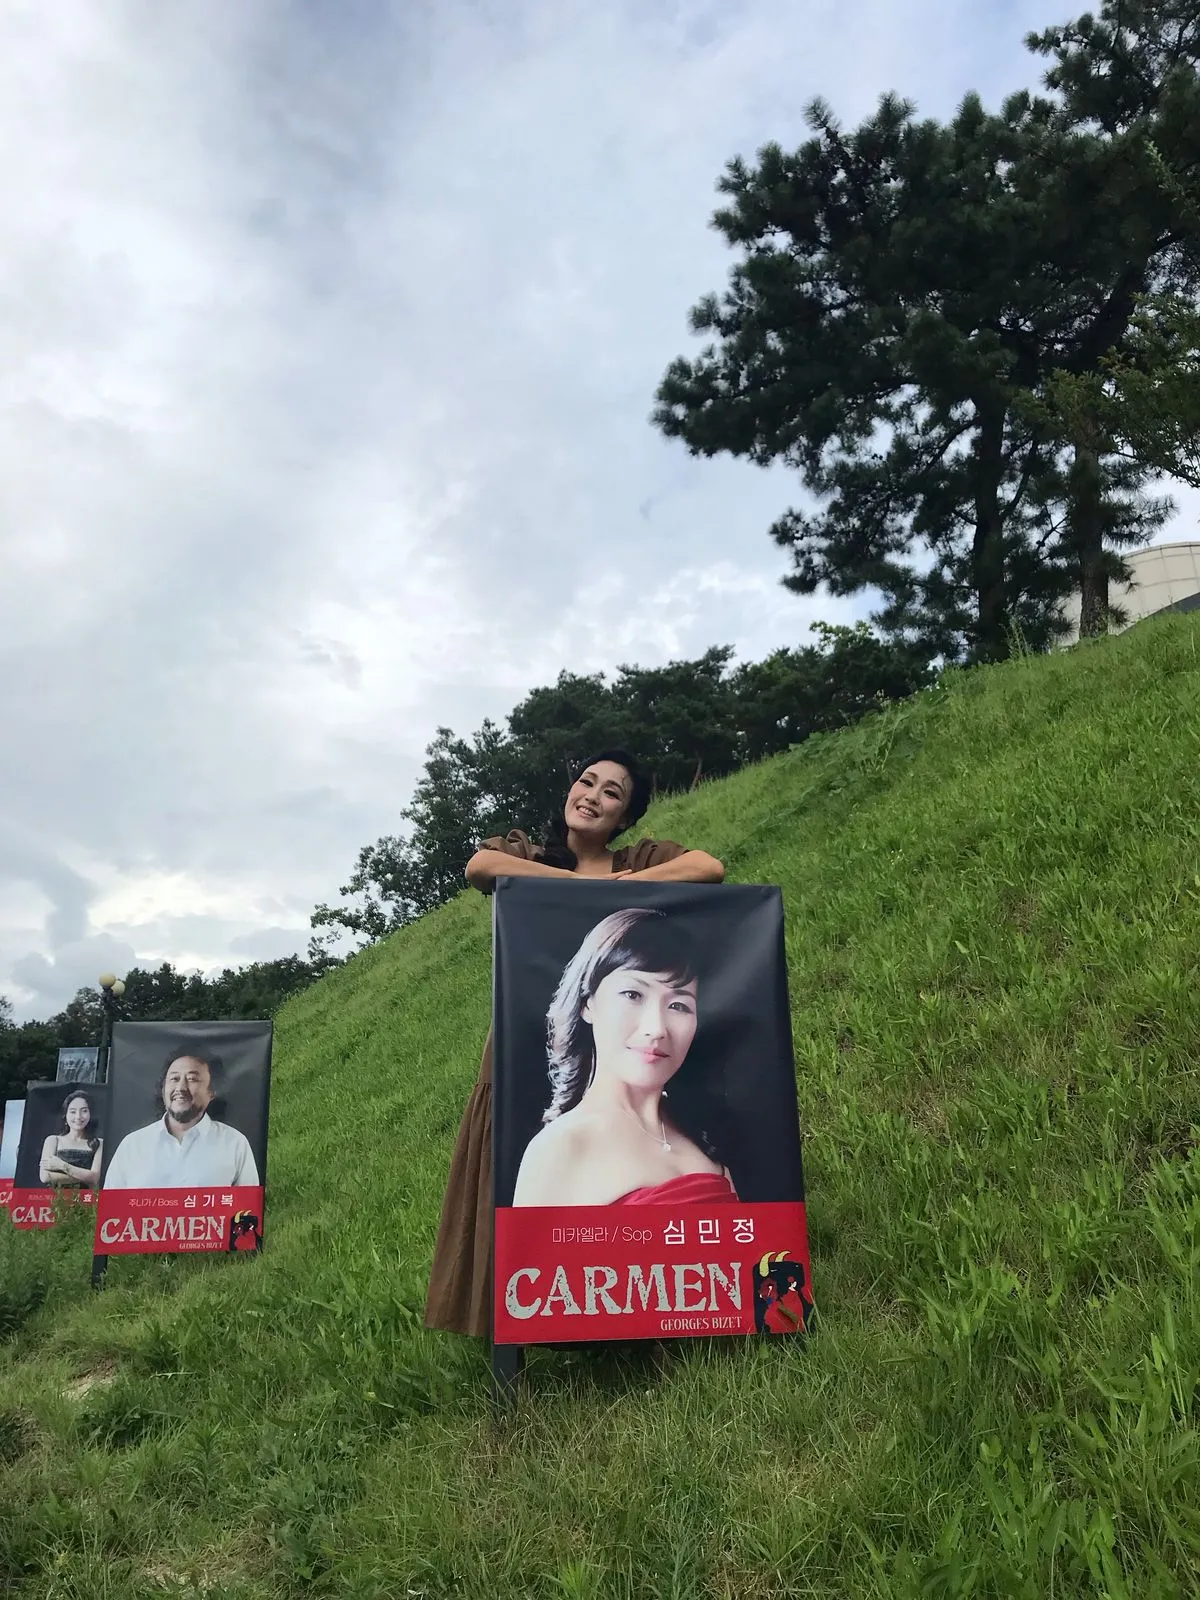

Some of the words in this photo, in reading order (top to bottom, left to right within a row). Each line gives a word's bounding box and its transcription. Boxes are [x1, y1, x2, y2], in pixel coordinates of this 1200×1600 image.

[100, 1215, 226, 1244] CARMEN
[505, 1262, 742, 1319] CARMEN
[660, 1317, 710, 1331] GEORGES
[711, 1316, 743, 1330] BIZET
